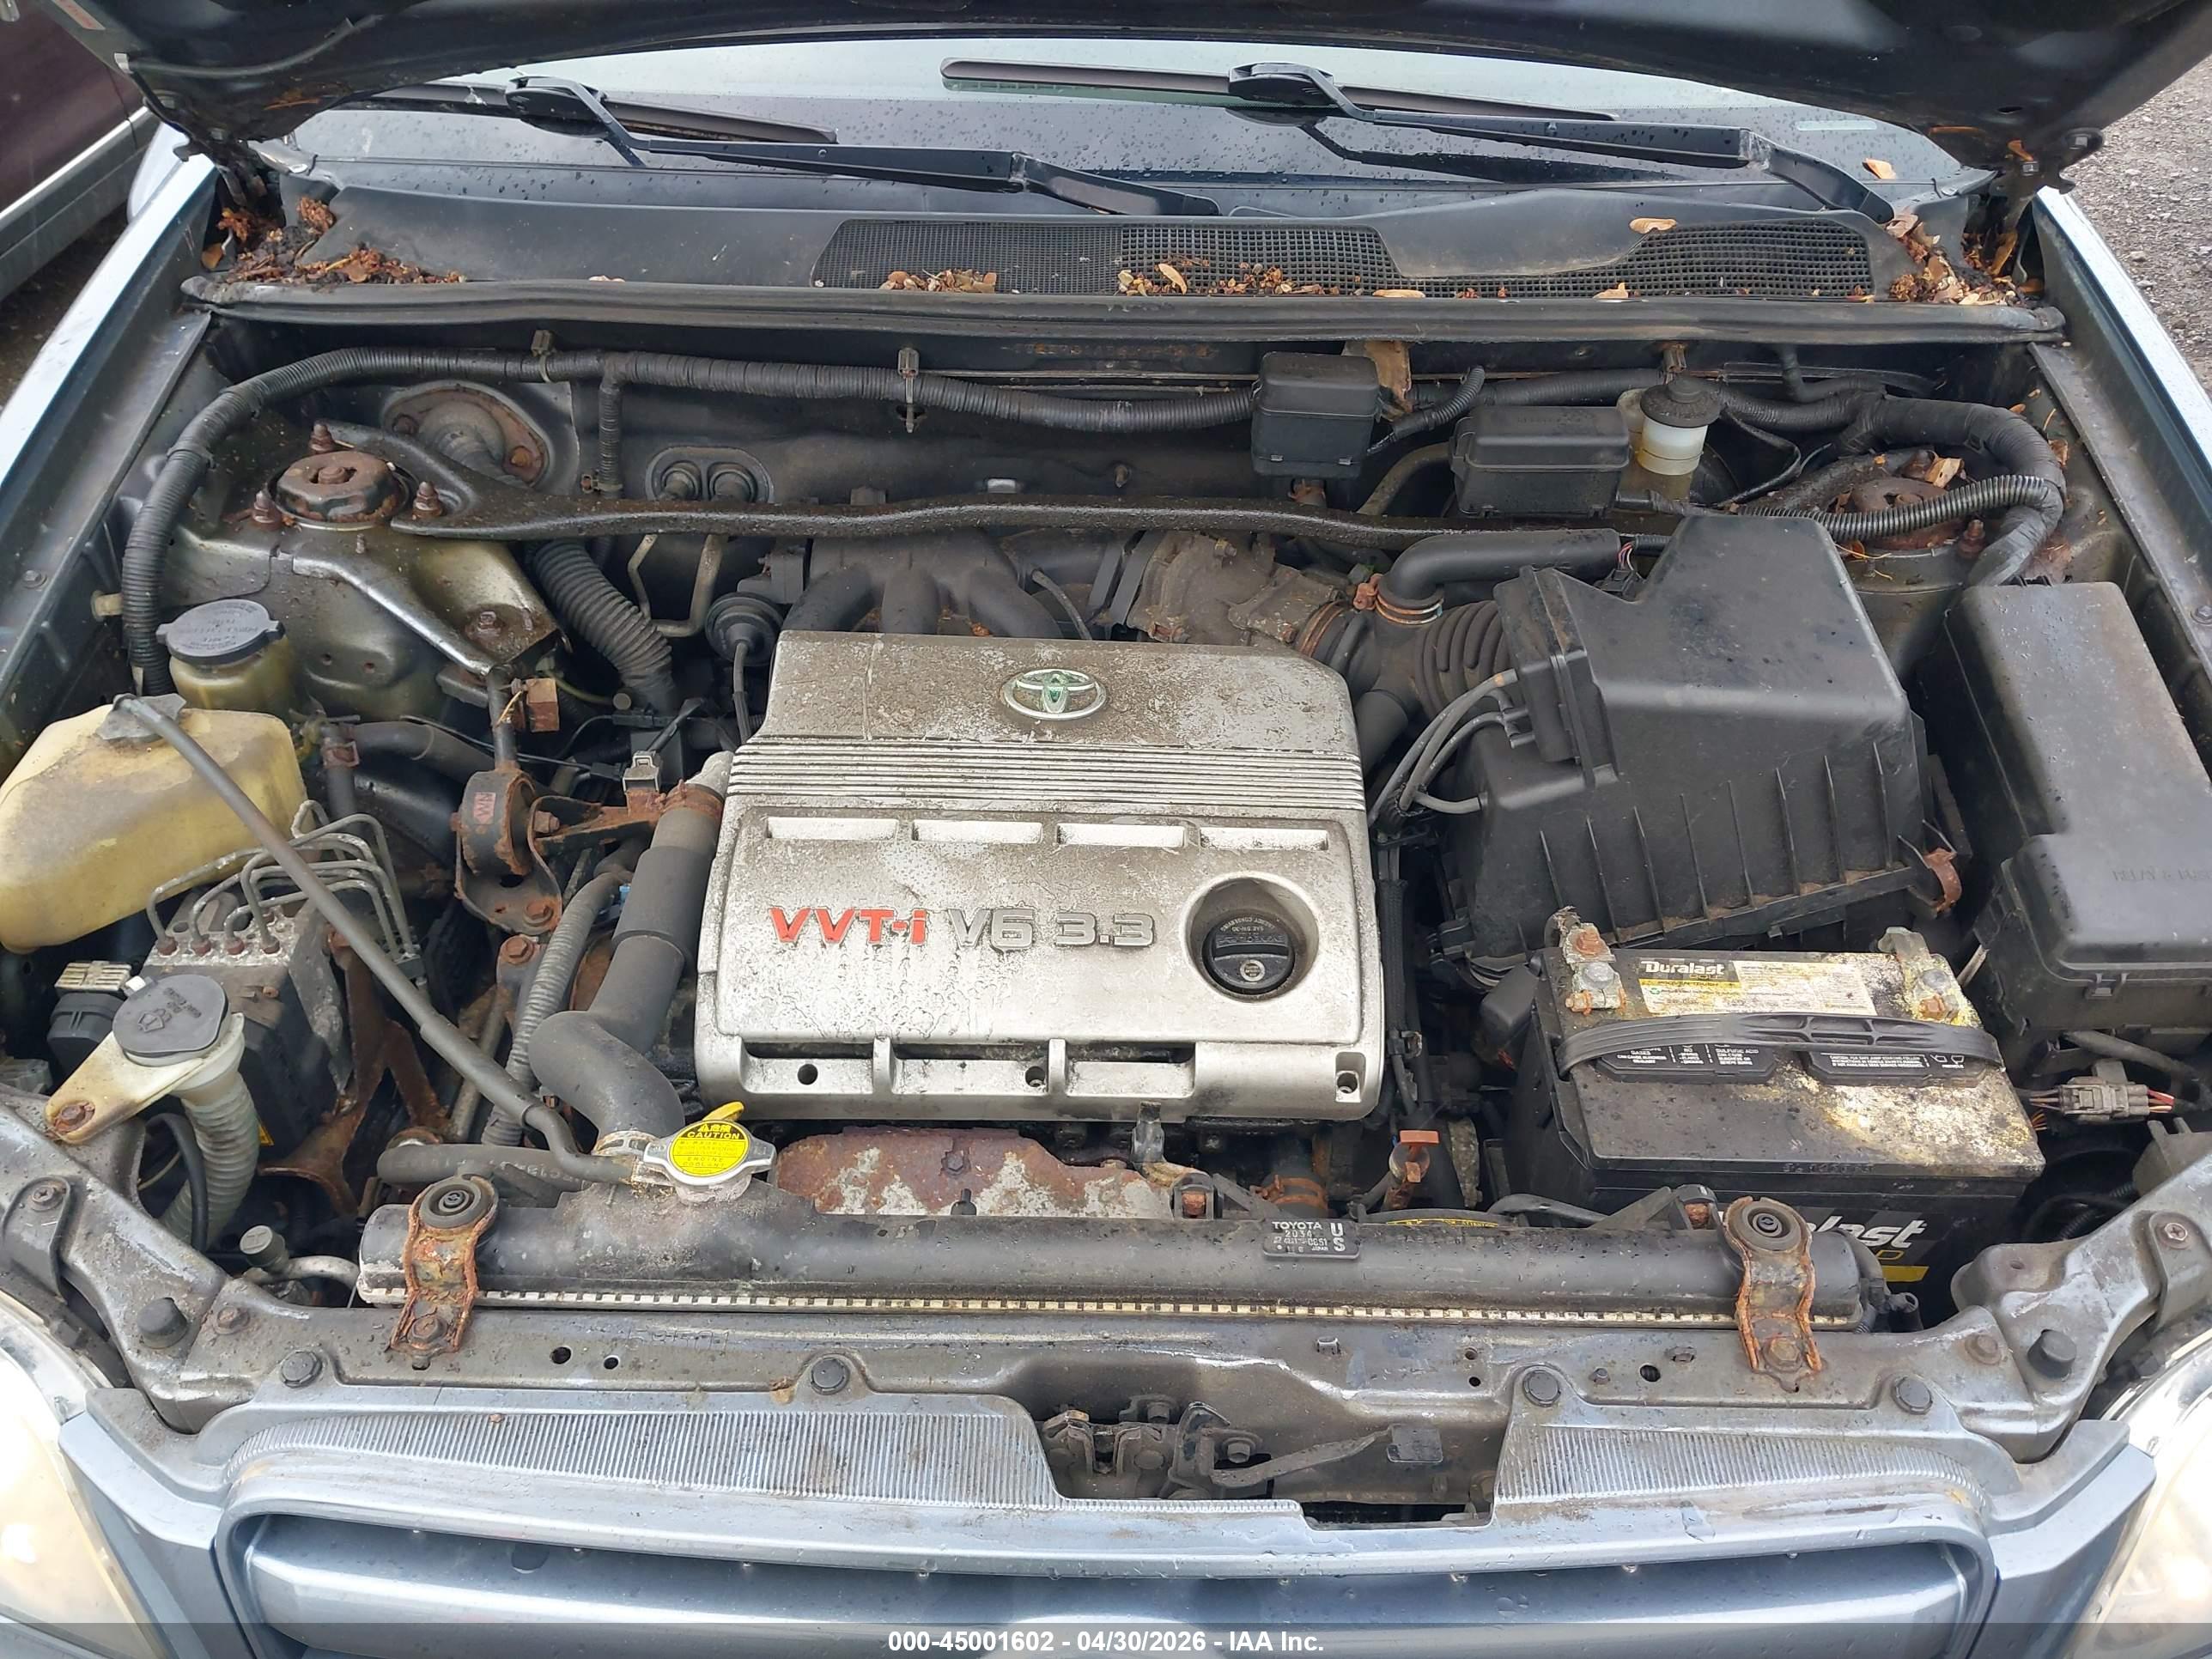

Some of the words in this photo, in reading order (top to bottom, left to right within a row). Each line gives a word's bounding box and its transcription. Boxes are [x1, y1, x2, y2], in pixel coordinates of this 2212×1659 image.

[772, 907, 927, 945] VVT-i
[948, 908, 1036, 949] V6
[1054, 911, 1156, 947] 3.3
[1641, 960, 1724, 975] Duralast
[687, 1132, 740, 1140] CAUTION
[1271, 1221, 1322, 1231] TOYOTA
[1330, 1222, 1344, 1237] U
[1333, 1237, 1346, 1252] S
